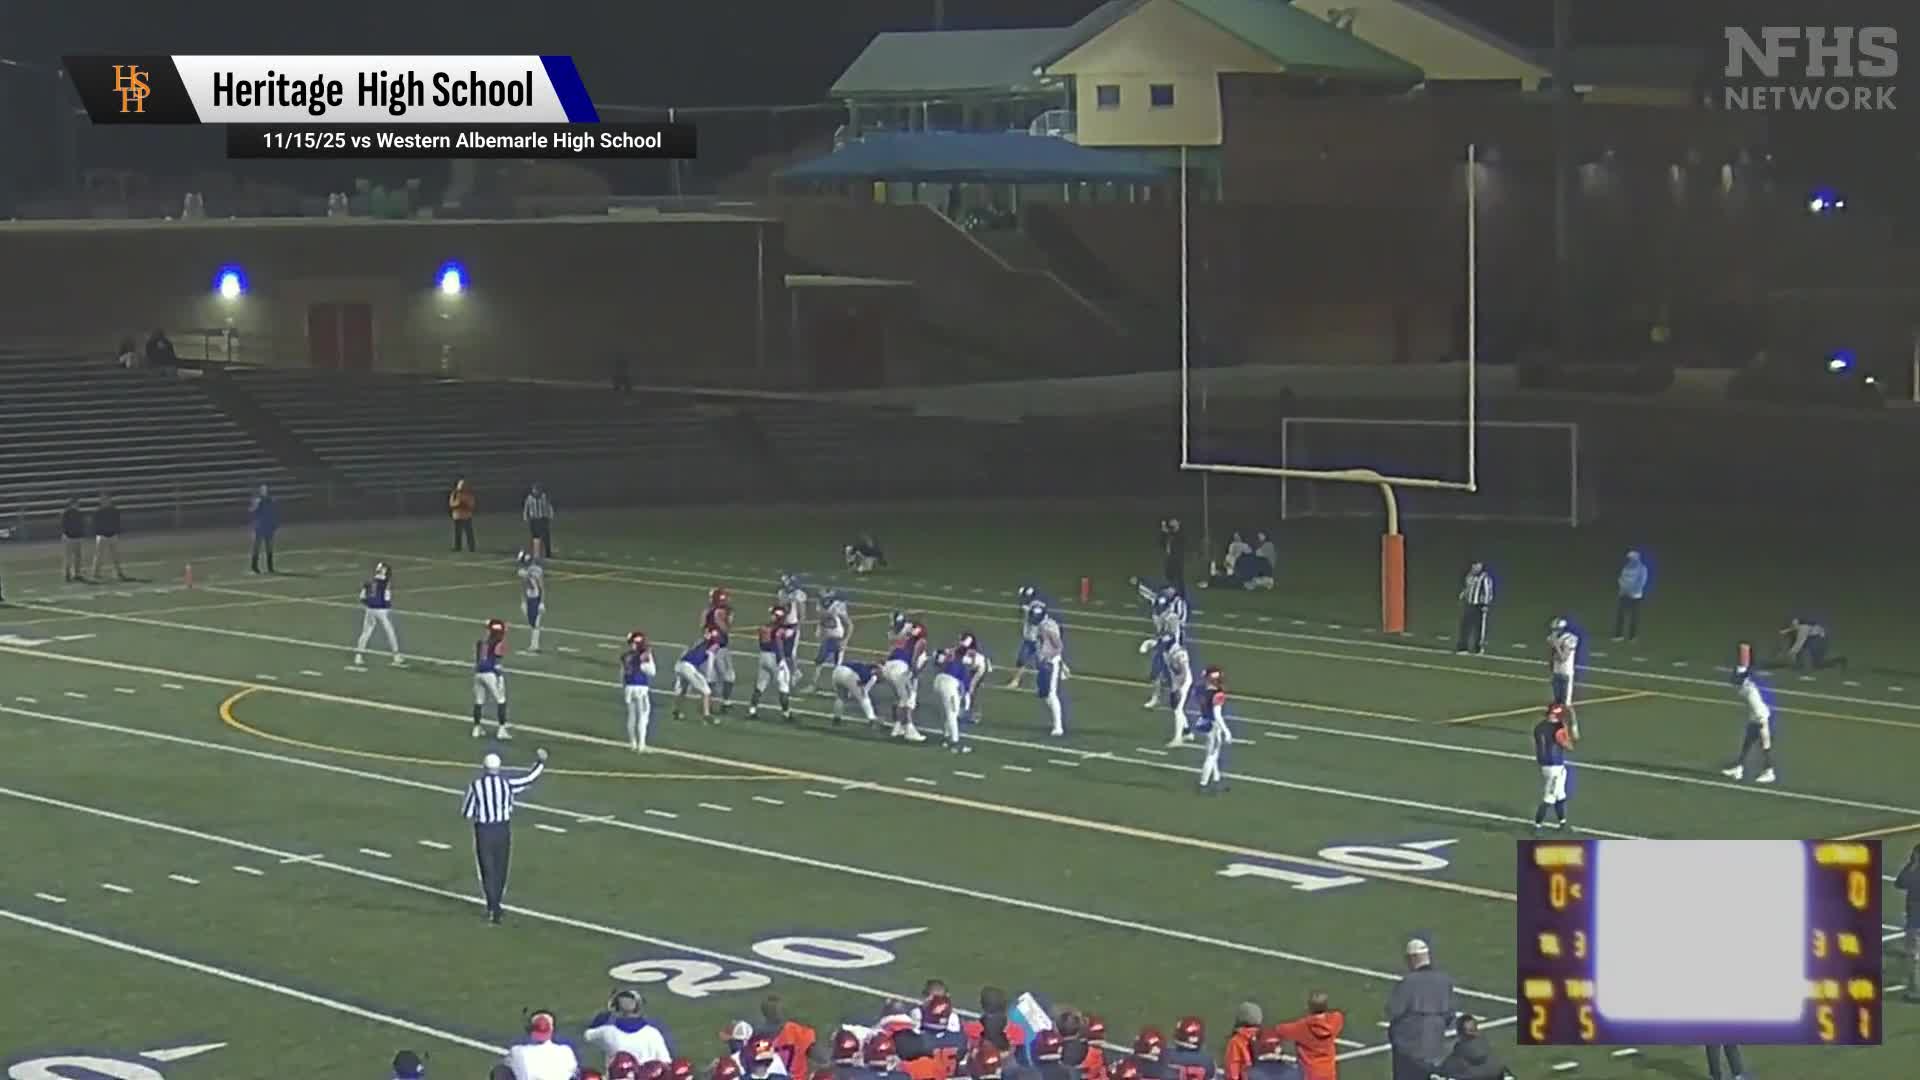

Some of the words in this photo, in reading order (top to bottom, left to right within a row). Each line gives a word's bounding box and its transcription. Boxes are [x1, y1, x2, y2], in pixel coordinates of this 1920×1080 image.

[1550, 872, 1567, 908] 0
[1848, 871, 1867, 908] 0
[1573, 930, 1587, 959] 3
[1812, 929, 1828, 959] 3
[1530, 1004, 1546, 1040] 2
